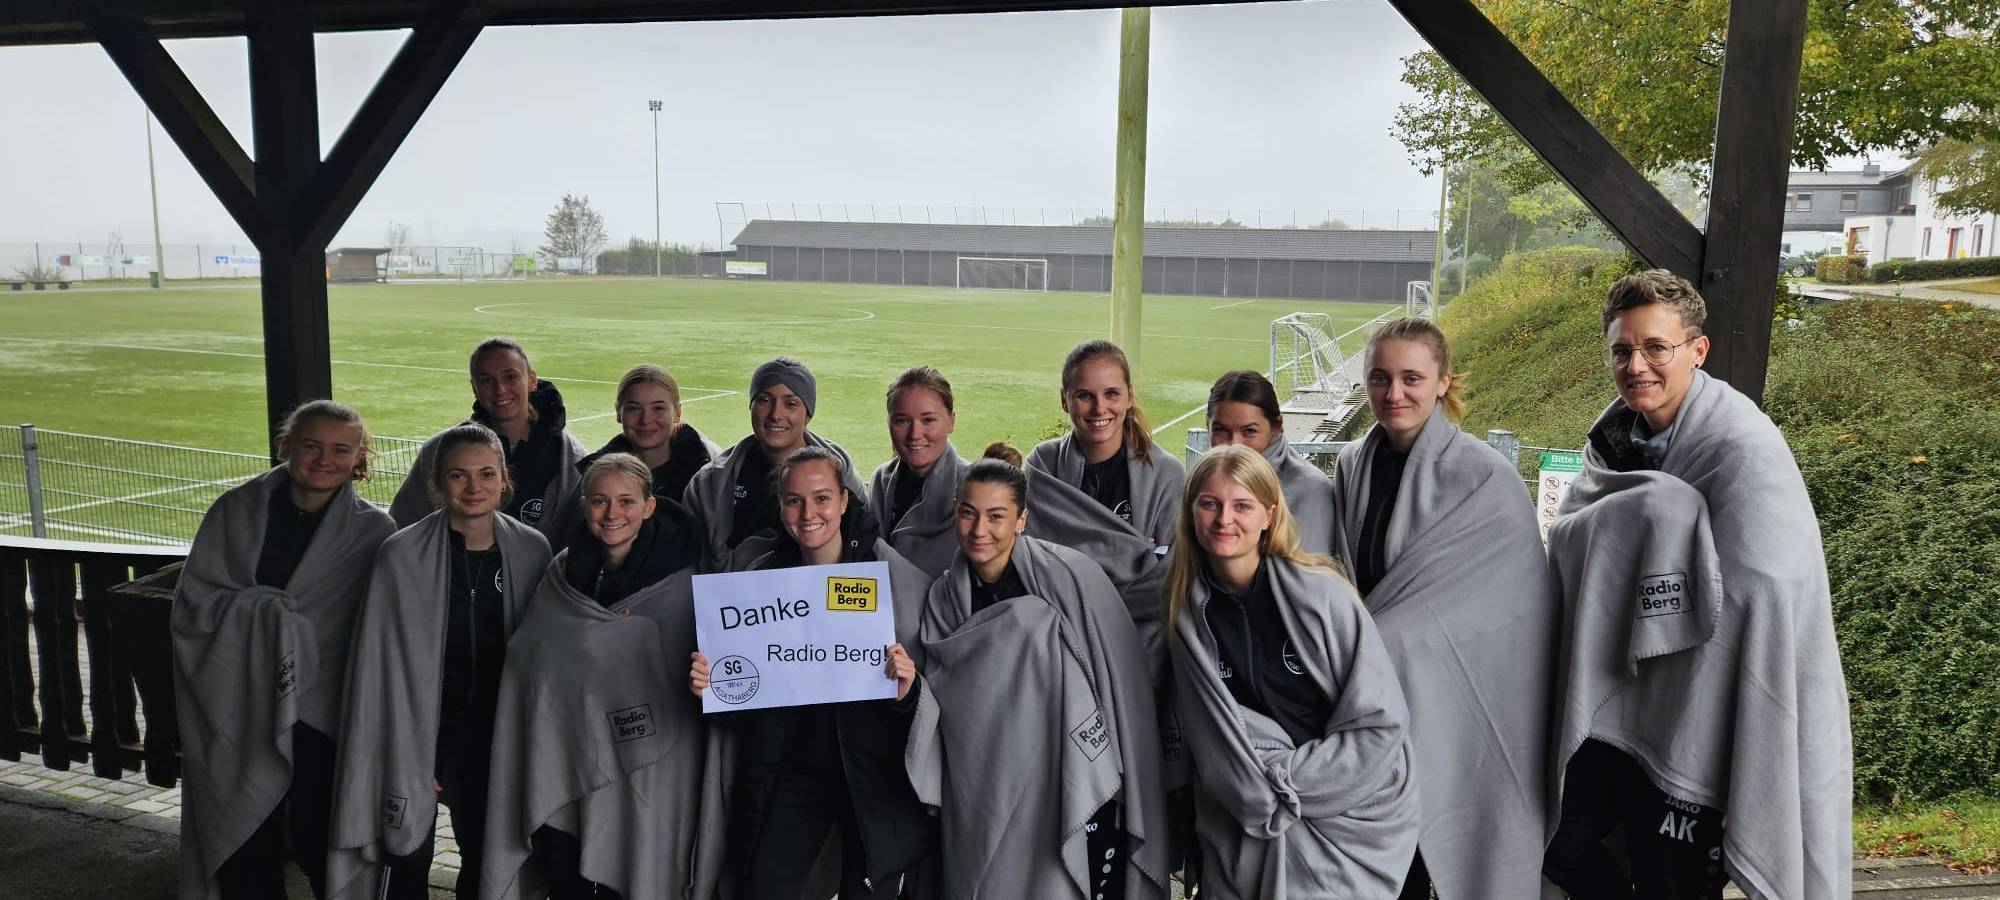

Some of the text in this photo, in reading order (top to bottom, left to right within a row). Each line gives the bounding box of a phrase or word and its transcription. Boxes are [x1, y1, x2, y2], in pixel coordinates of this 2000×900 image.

[1551, 455, 1574, 463] Bitte
[531, 502, 542, 511] SG
[834, 583, 871, 595] Radio
[1638, 579, 1681, 597] Radio
[837, 595, 867, 608] Berg
[1642, 597, 1681, 610] Berg
[720, 597, 810, 630] Danke
[767, 643, 888, 667] Radio Berg!
[724, 660, 742, 675] SG
[714, 681, 758, 701] AGATHABERG
[614, 711, 646, 727] Radio
[619, 725, 646, 737] Berg
[1664, 794, 1700, 814] JAKO
[1658, 810, 1699, 843] AK
